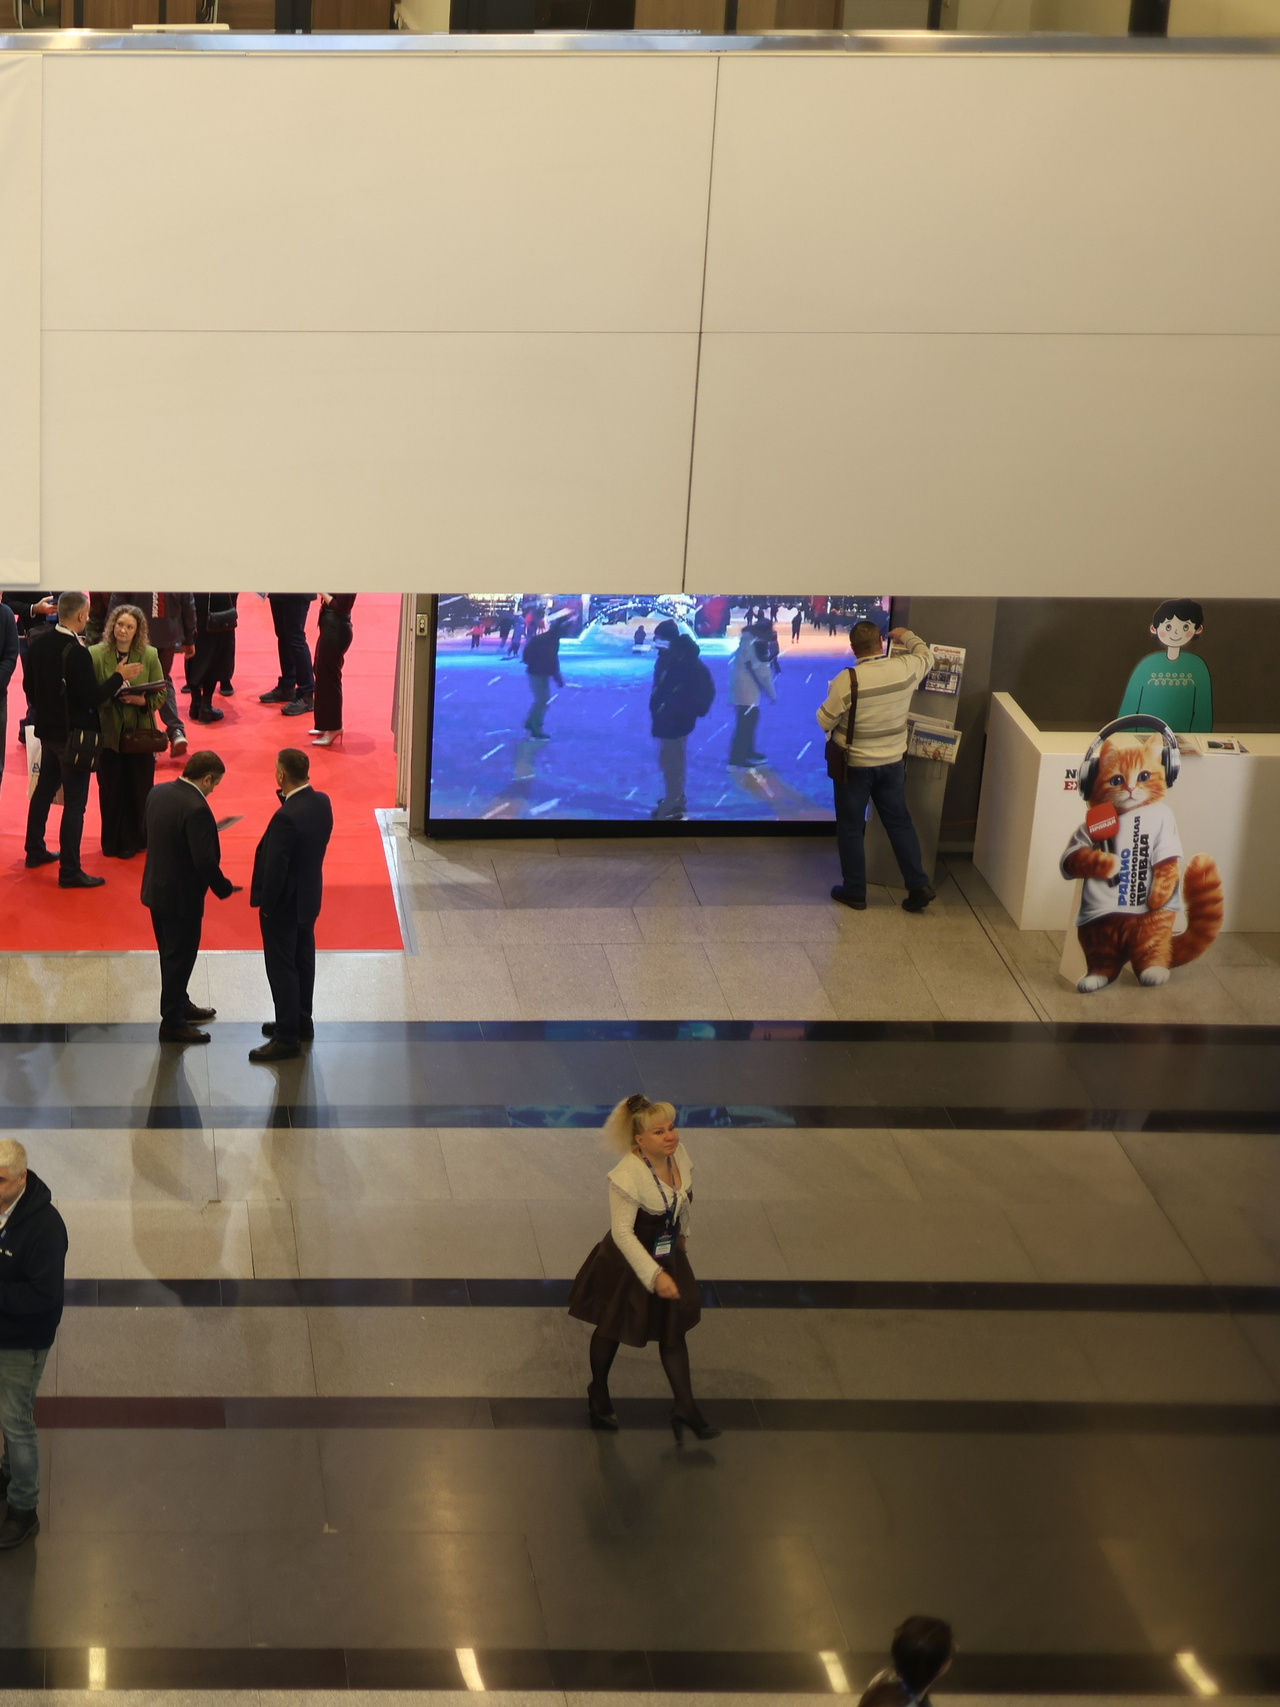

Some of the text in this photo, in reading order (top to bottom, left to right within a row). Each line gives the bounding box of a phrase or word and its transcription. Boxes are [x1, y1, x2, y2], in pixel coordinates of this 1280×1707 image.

[1118, 848, 1131, 907] РАДИО
[1129, 816, 1141, 907] КОМСОМОЛЬСКАЯ
[1137, 834, 1150, 907] ПРАВДА
